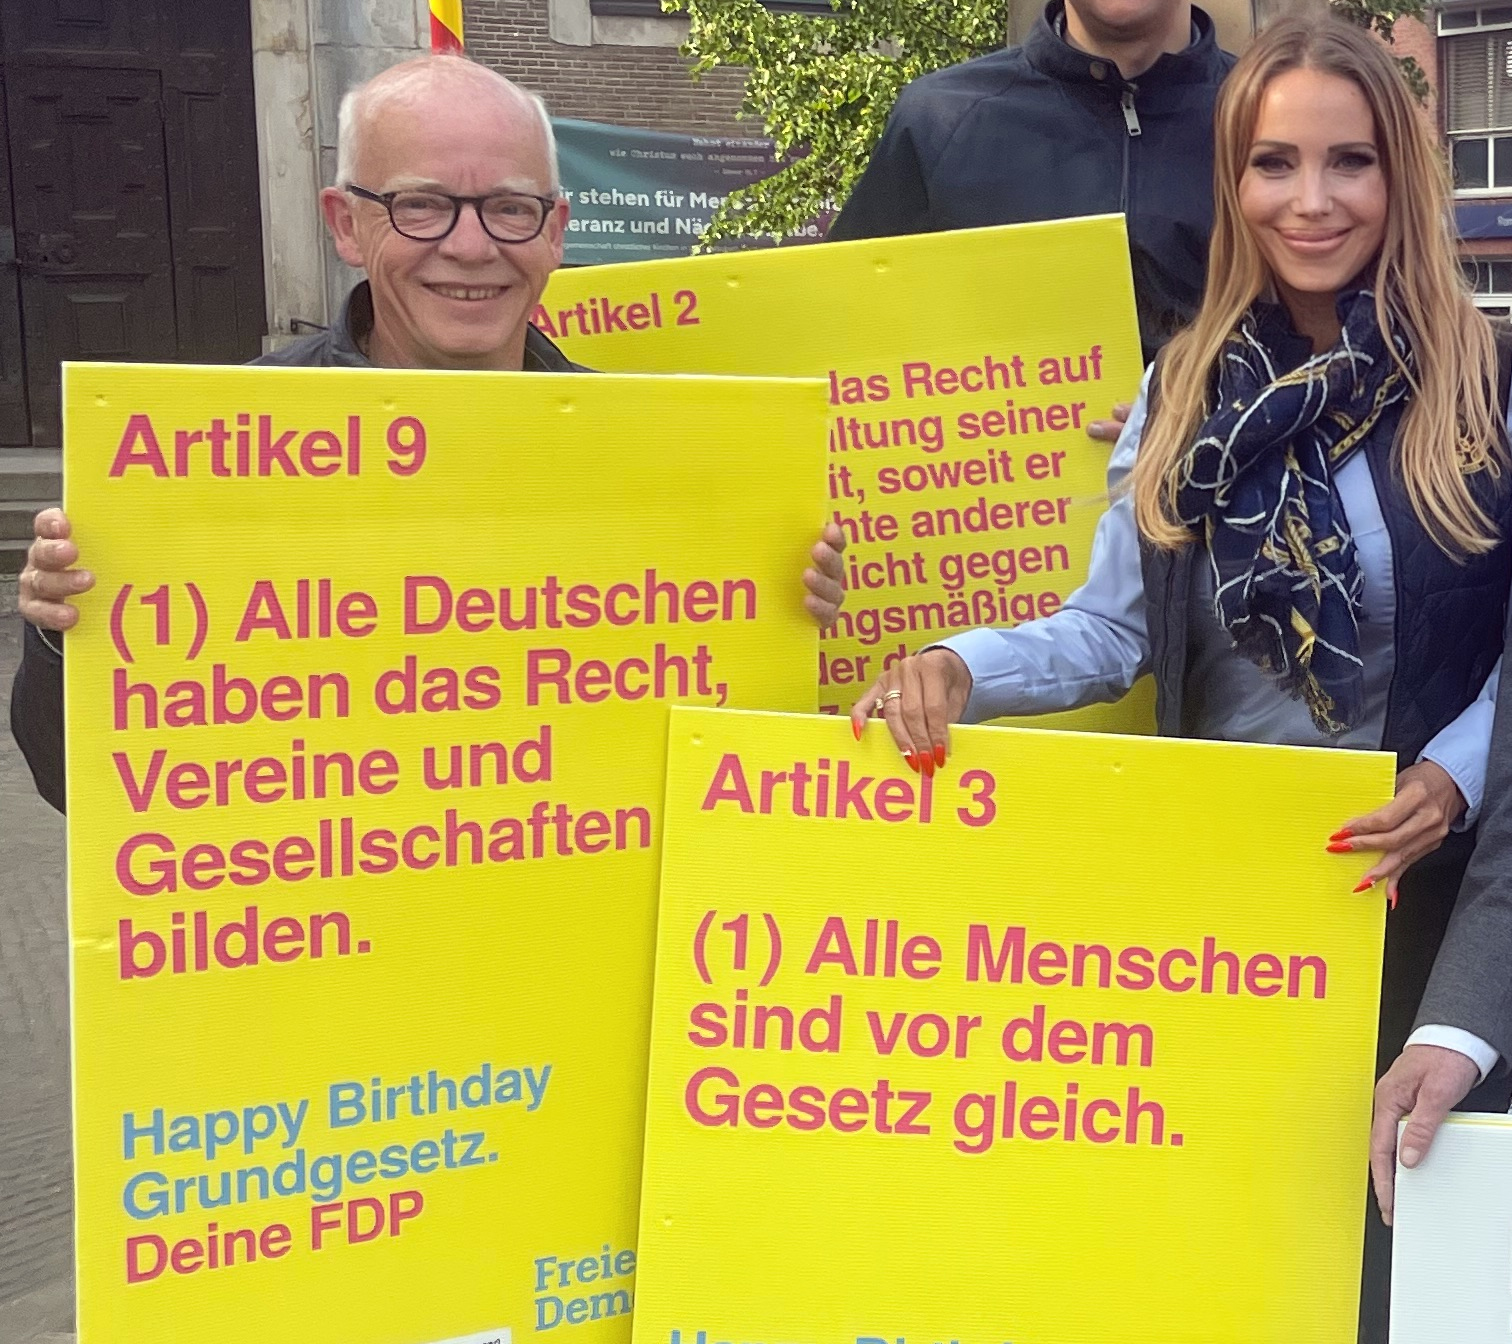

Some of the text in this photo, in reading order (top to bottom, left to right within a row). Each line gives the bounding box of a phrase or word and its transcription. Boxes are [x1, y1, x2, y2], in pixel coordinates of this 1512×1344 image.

[578, 188, 685, 208] stehen für
[629, 217, 670, 235] und
[672, 289, 701, 327] 2
[903, 345, 1103, 398] Recht auf
[110, 413, 427, 477] Artikel 9
[957, 399, 1086, 439] seiner
[878, 448, 1066, 494] soweit er
[911, 495, 1072, 540] anderer
[939, 541, 1071, 591] gegen
[109, 568, 756, 662] (1) Alle Deutschen
[113, 643, 734, 730] haben das Recht,
[112, 725, 552, 812] Vereine und
[700, 752, 996, 827] Artikel 3
[115, 801, 650, 896] Gesellschaften
[118, 905, 370, 979] bilden.
[694, 910, 1327, 999] (1) Alle Menschen
[689, 990, 1153, 1067] sind vor dem
[685, 1066, 1183, 1154] Gesetz gleich.
